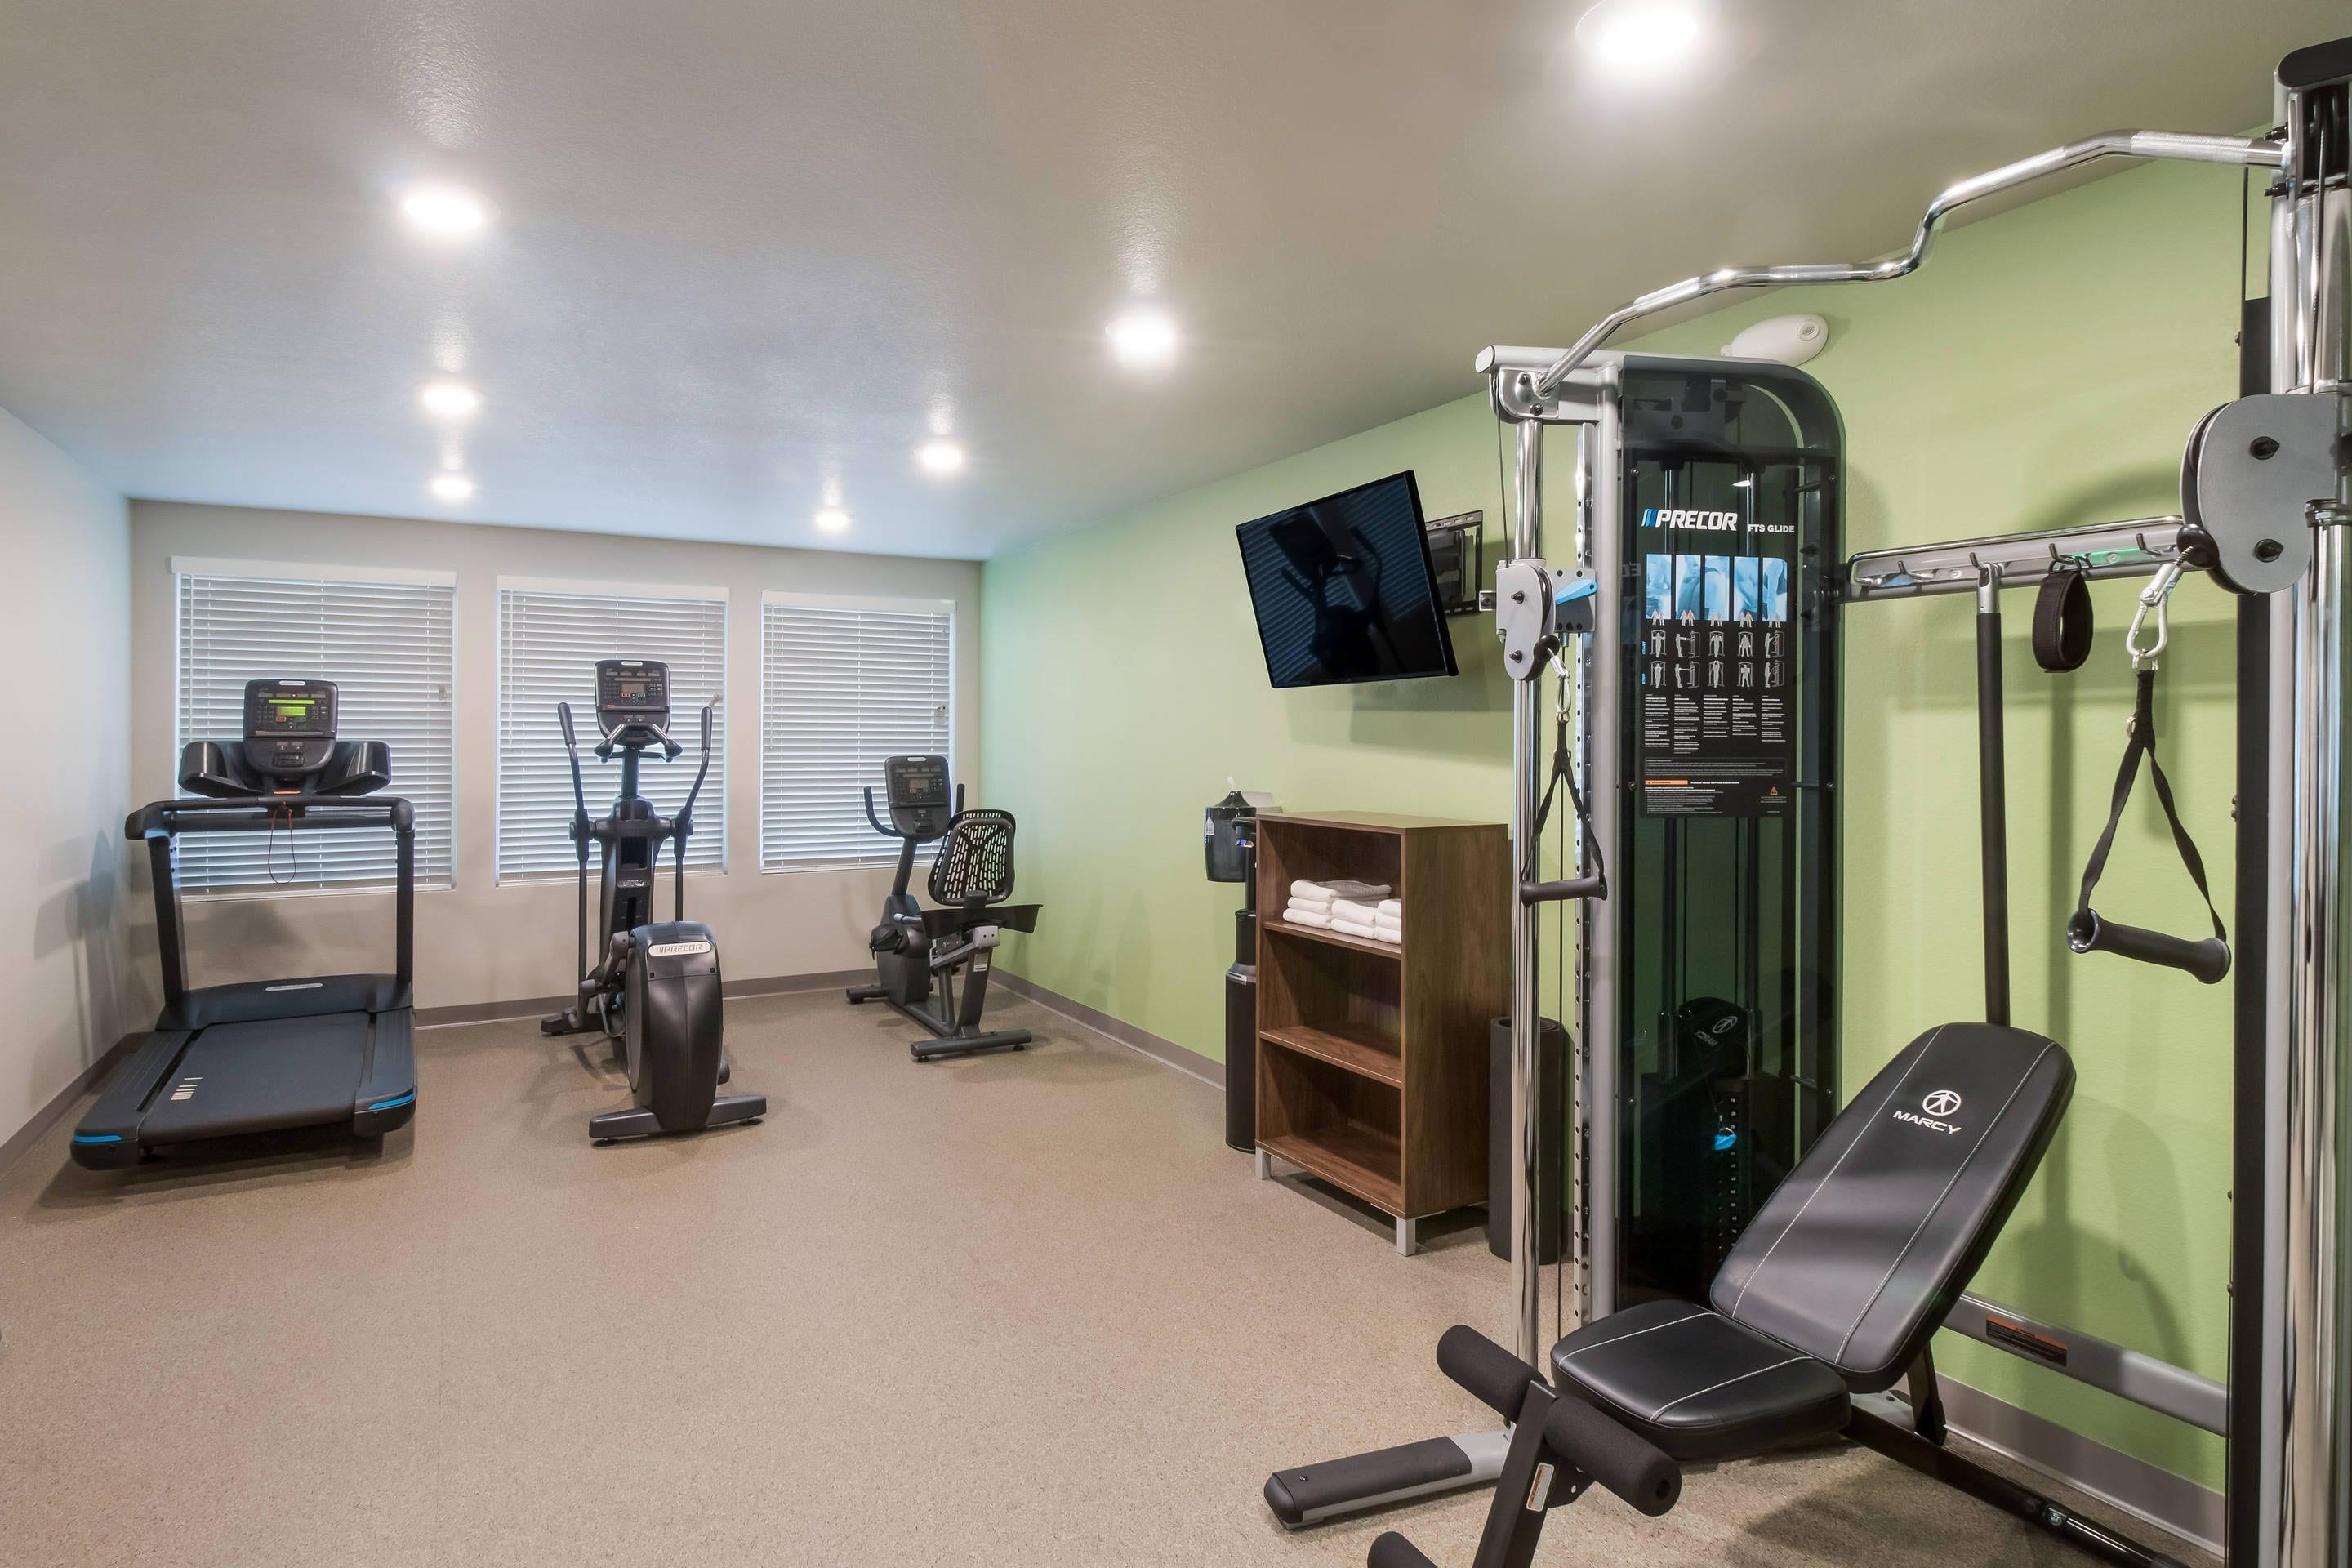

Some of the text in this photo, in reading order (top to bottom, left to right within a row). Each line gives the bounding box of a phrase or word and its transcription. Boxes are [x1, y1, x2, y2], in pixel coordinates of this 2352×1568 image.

[1655, 509, 1739, 531] PRECOR
[1748, 523, 1795, 533] FTS GLIDE
[664, 943, 702, 954] PRECOR
[1892, 1110, 1962, 1134] MARCY
